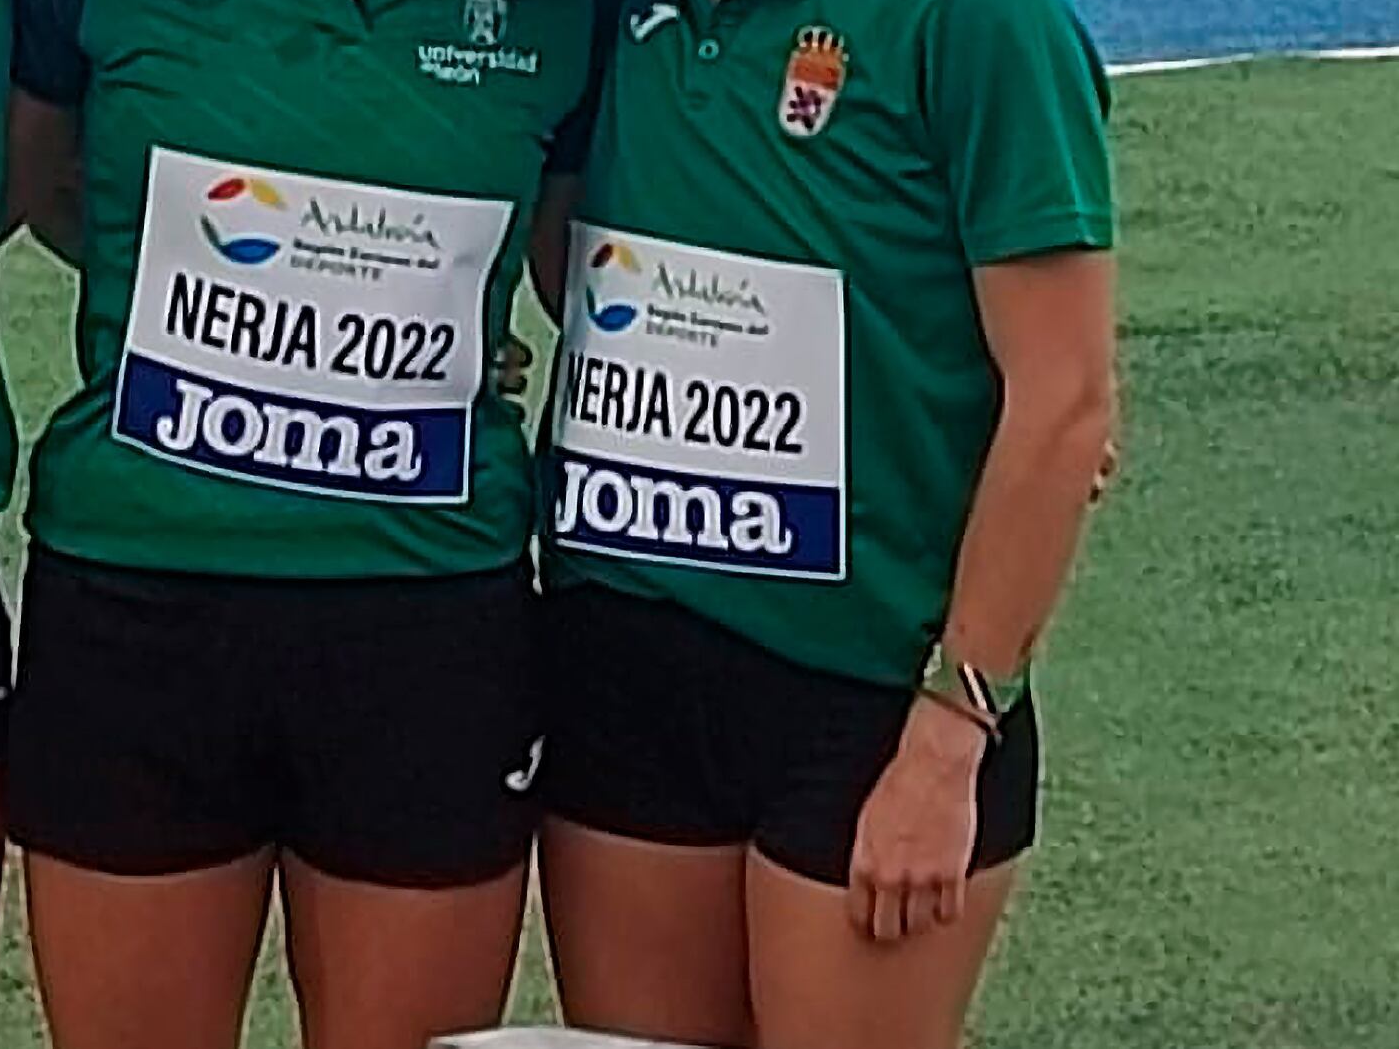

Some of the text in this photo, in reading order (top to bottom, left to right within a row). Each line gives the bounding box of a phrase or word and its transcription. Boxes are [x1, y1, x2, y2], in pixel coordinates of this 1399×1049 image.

[166, 272, 455, 382] NERJA 2022
[684, 380, 803, 454] 2022
